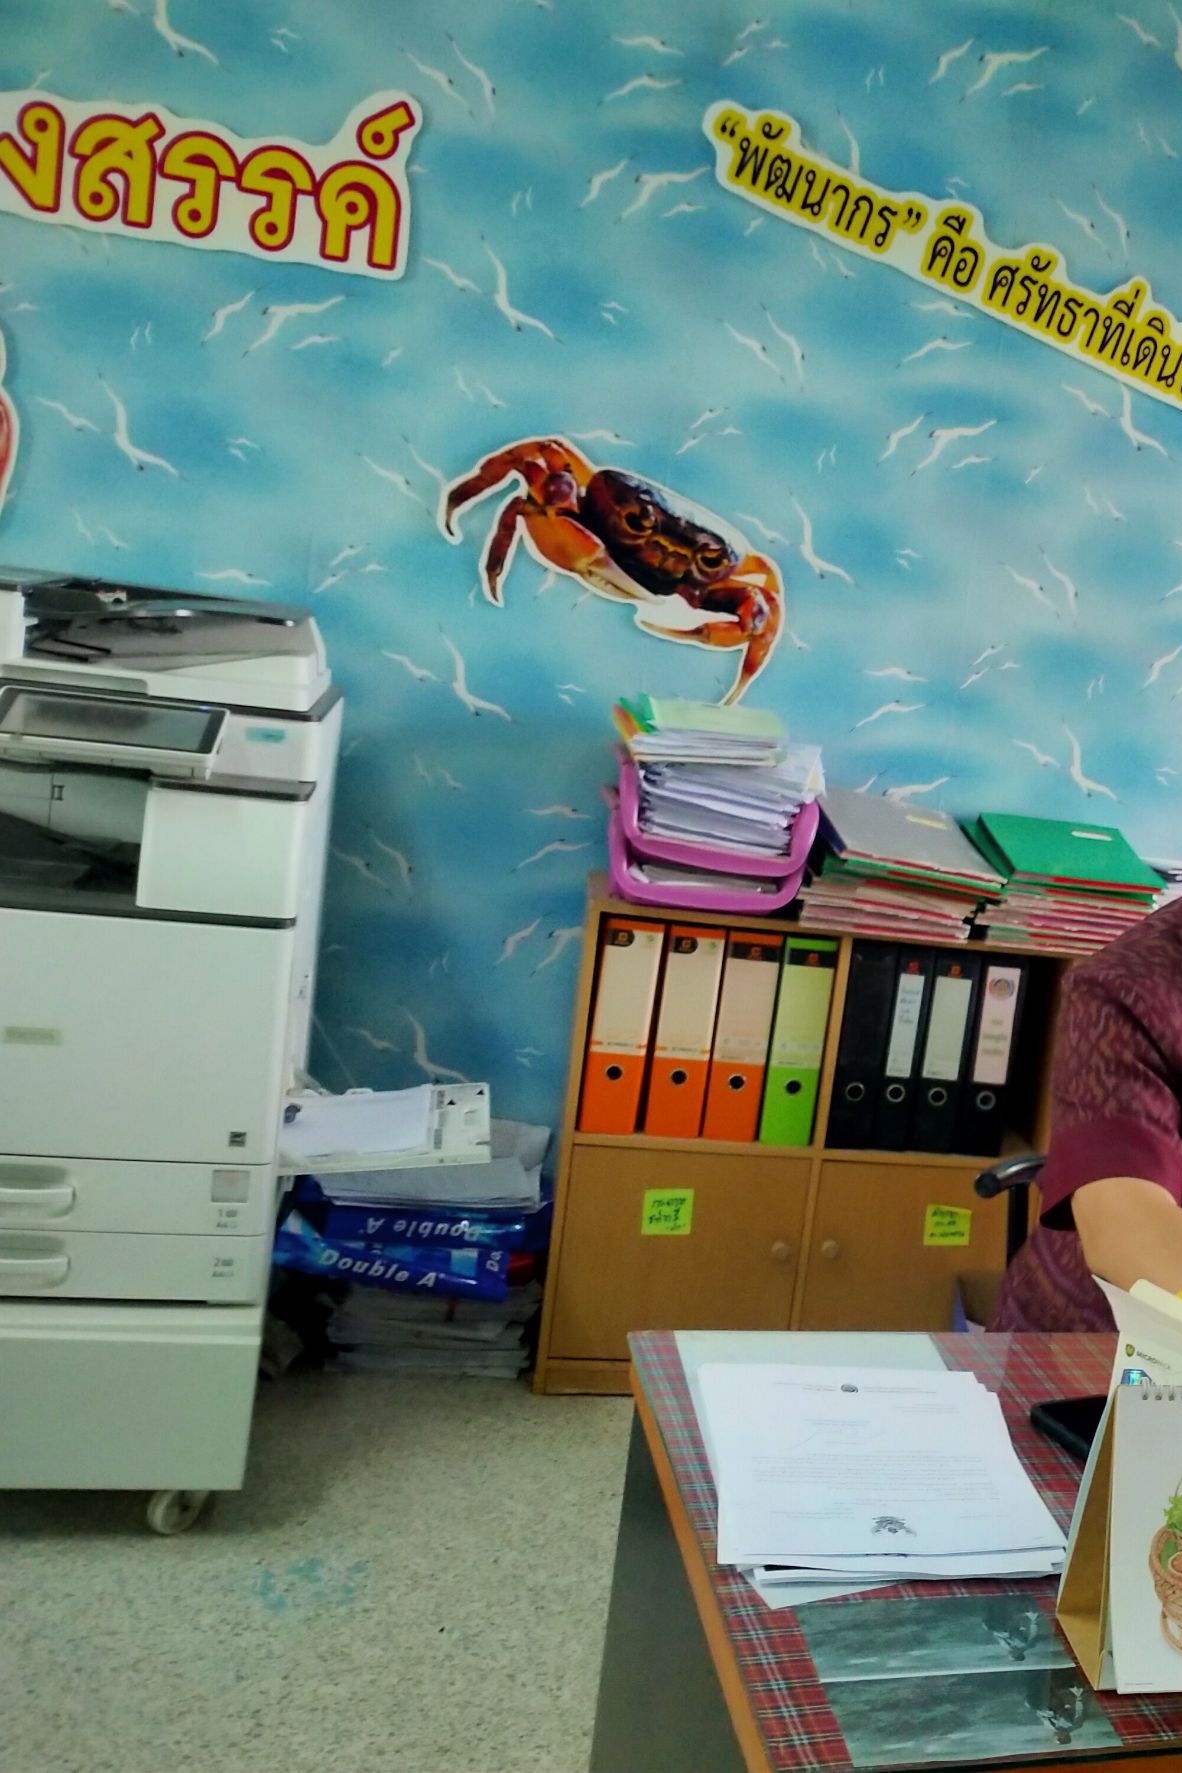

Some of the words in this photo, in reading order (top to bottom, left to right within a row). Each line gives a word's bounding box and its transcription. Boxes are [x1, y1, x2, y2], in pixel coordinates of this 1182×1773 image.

[927, 214, 980, 288] คือ
[319, 1249, 411, 1282] Double
[416, 1271, 437, 1288] A
